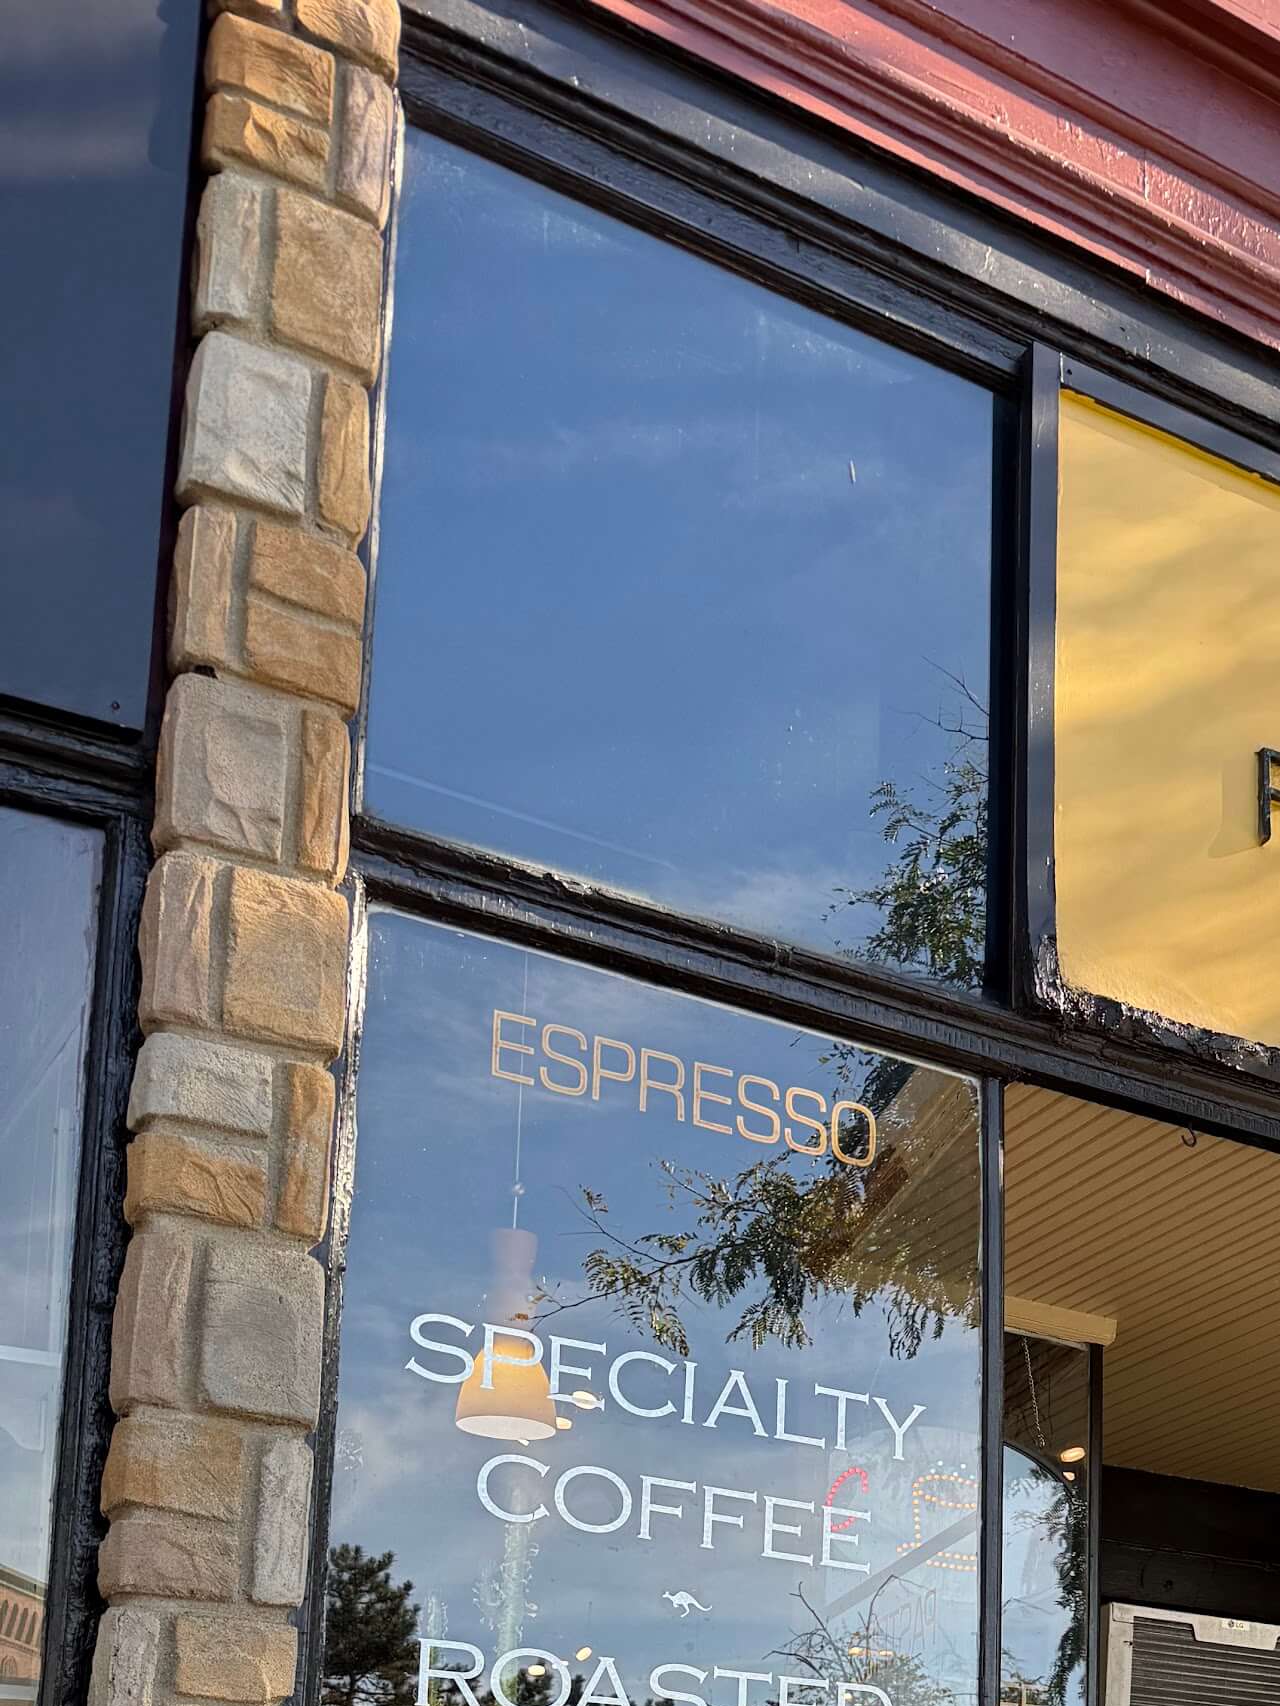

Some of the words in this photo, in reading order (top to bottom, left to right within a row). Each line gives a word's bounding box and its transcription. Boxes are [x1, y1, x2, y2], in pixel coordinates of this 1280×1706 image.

[490, 1009, 877, 1167] ESPRESSO
[404, 1312, 927, 1460] SPECIALTY
[476, 1454, 872, 1573] COFFEE
